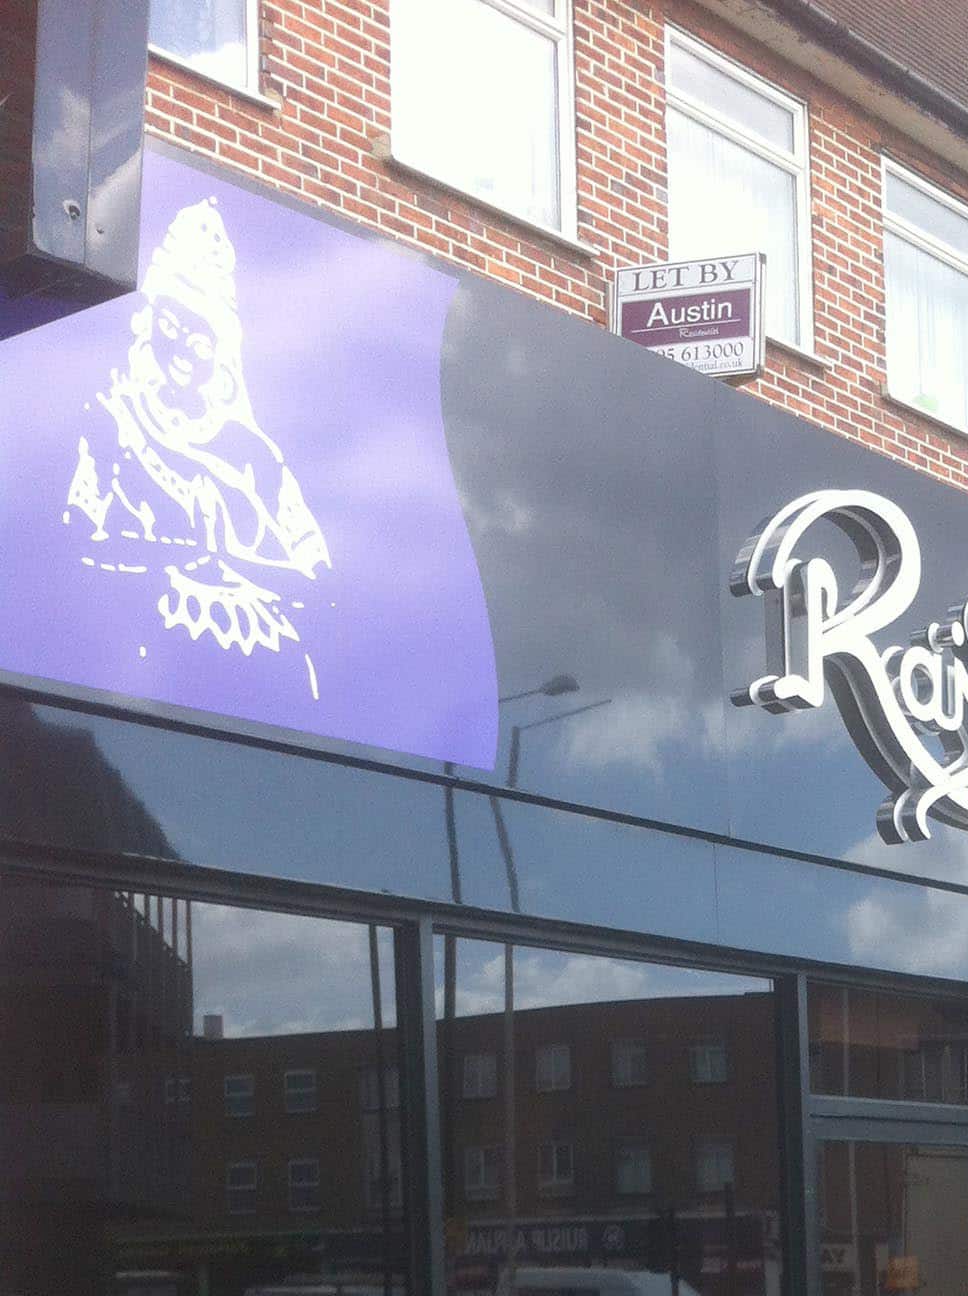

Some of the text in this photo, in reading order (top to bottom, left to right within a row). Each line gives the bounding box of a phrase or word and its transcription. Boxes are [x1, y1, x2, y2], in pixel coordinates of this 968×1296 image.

[632, 260, 739, 292] LET BY
[646, 298, 732, 328] Austin
[681, 341, 744, 362] 613000
